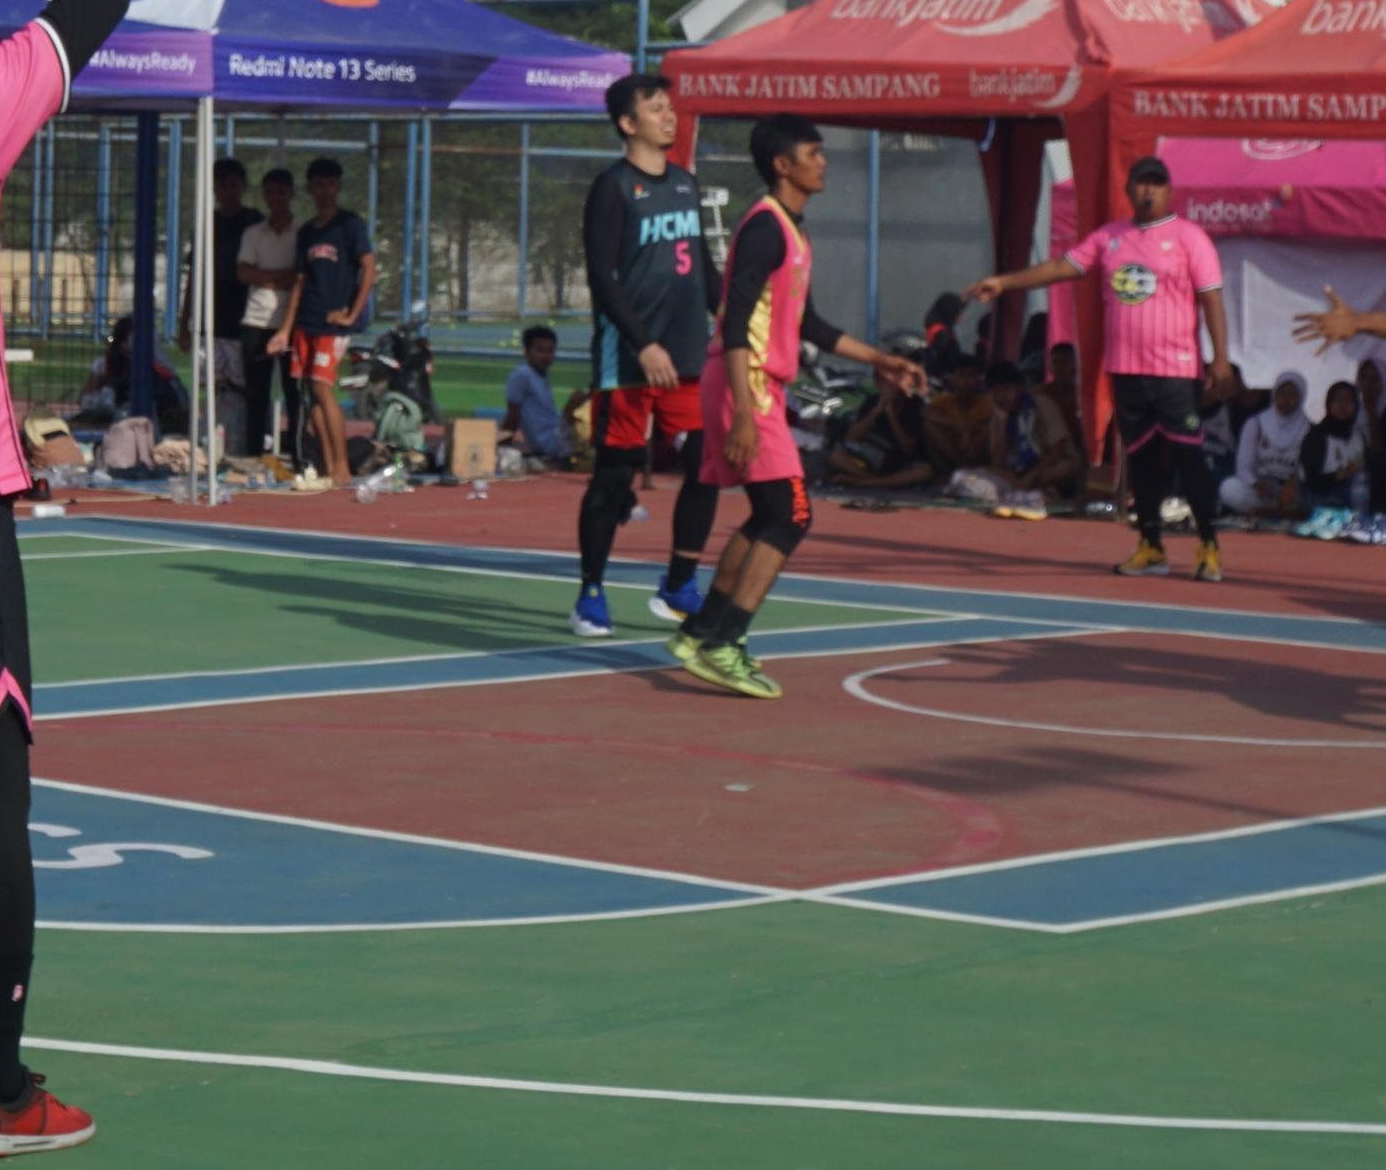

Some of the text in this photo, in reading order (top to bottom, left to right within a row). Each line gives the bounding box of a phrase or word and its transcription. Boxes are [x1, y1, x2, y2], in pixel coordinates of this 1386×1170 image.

[228, 53, 417, 82] Redmi Note 13 Series
[525, 68, 614, 92] #AlwaysRead
[678, 68, 1055, 103] BANK JATIM SAMPANG bankjatim
[1133, 91, 1209, 117] BANK
[1214, 92, 1301, 119] JATIM
[675, 241, 693, 276] 5
